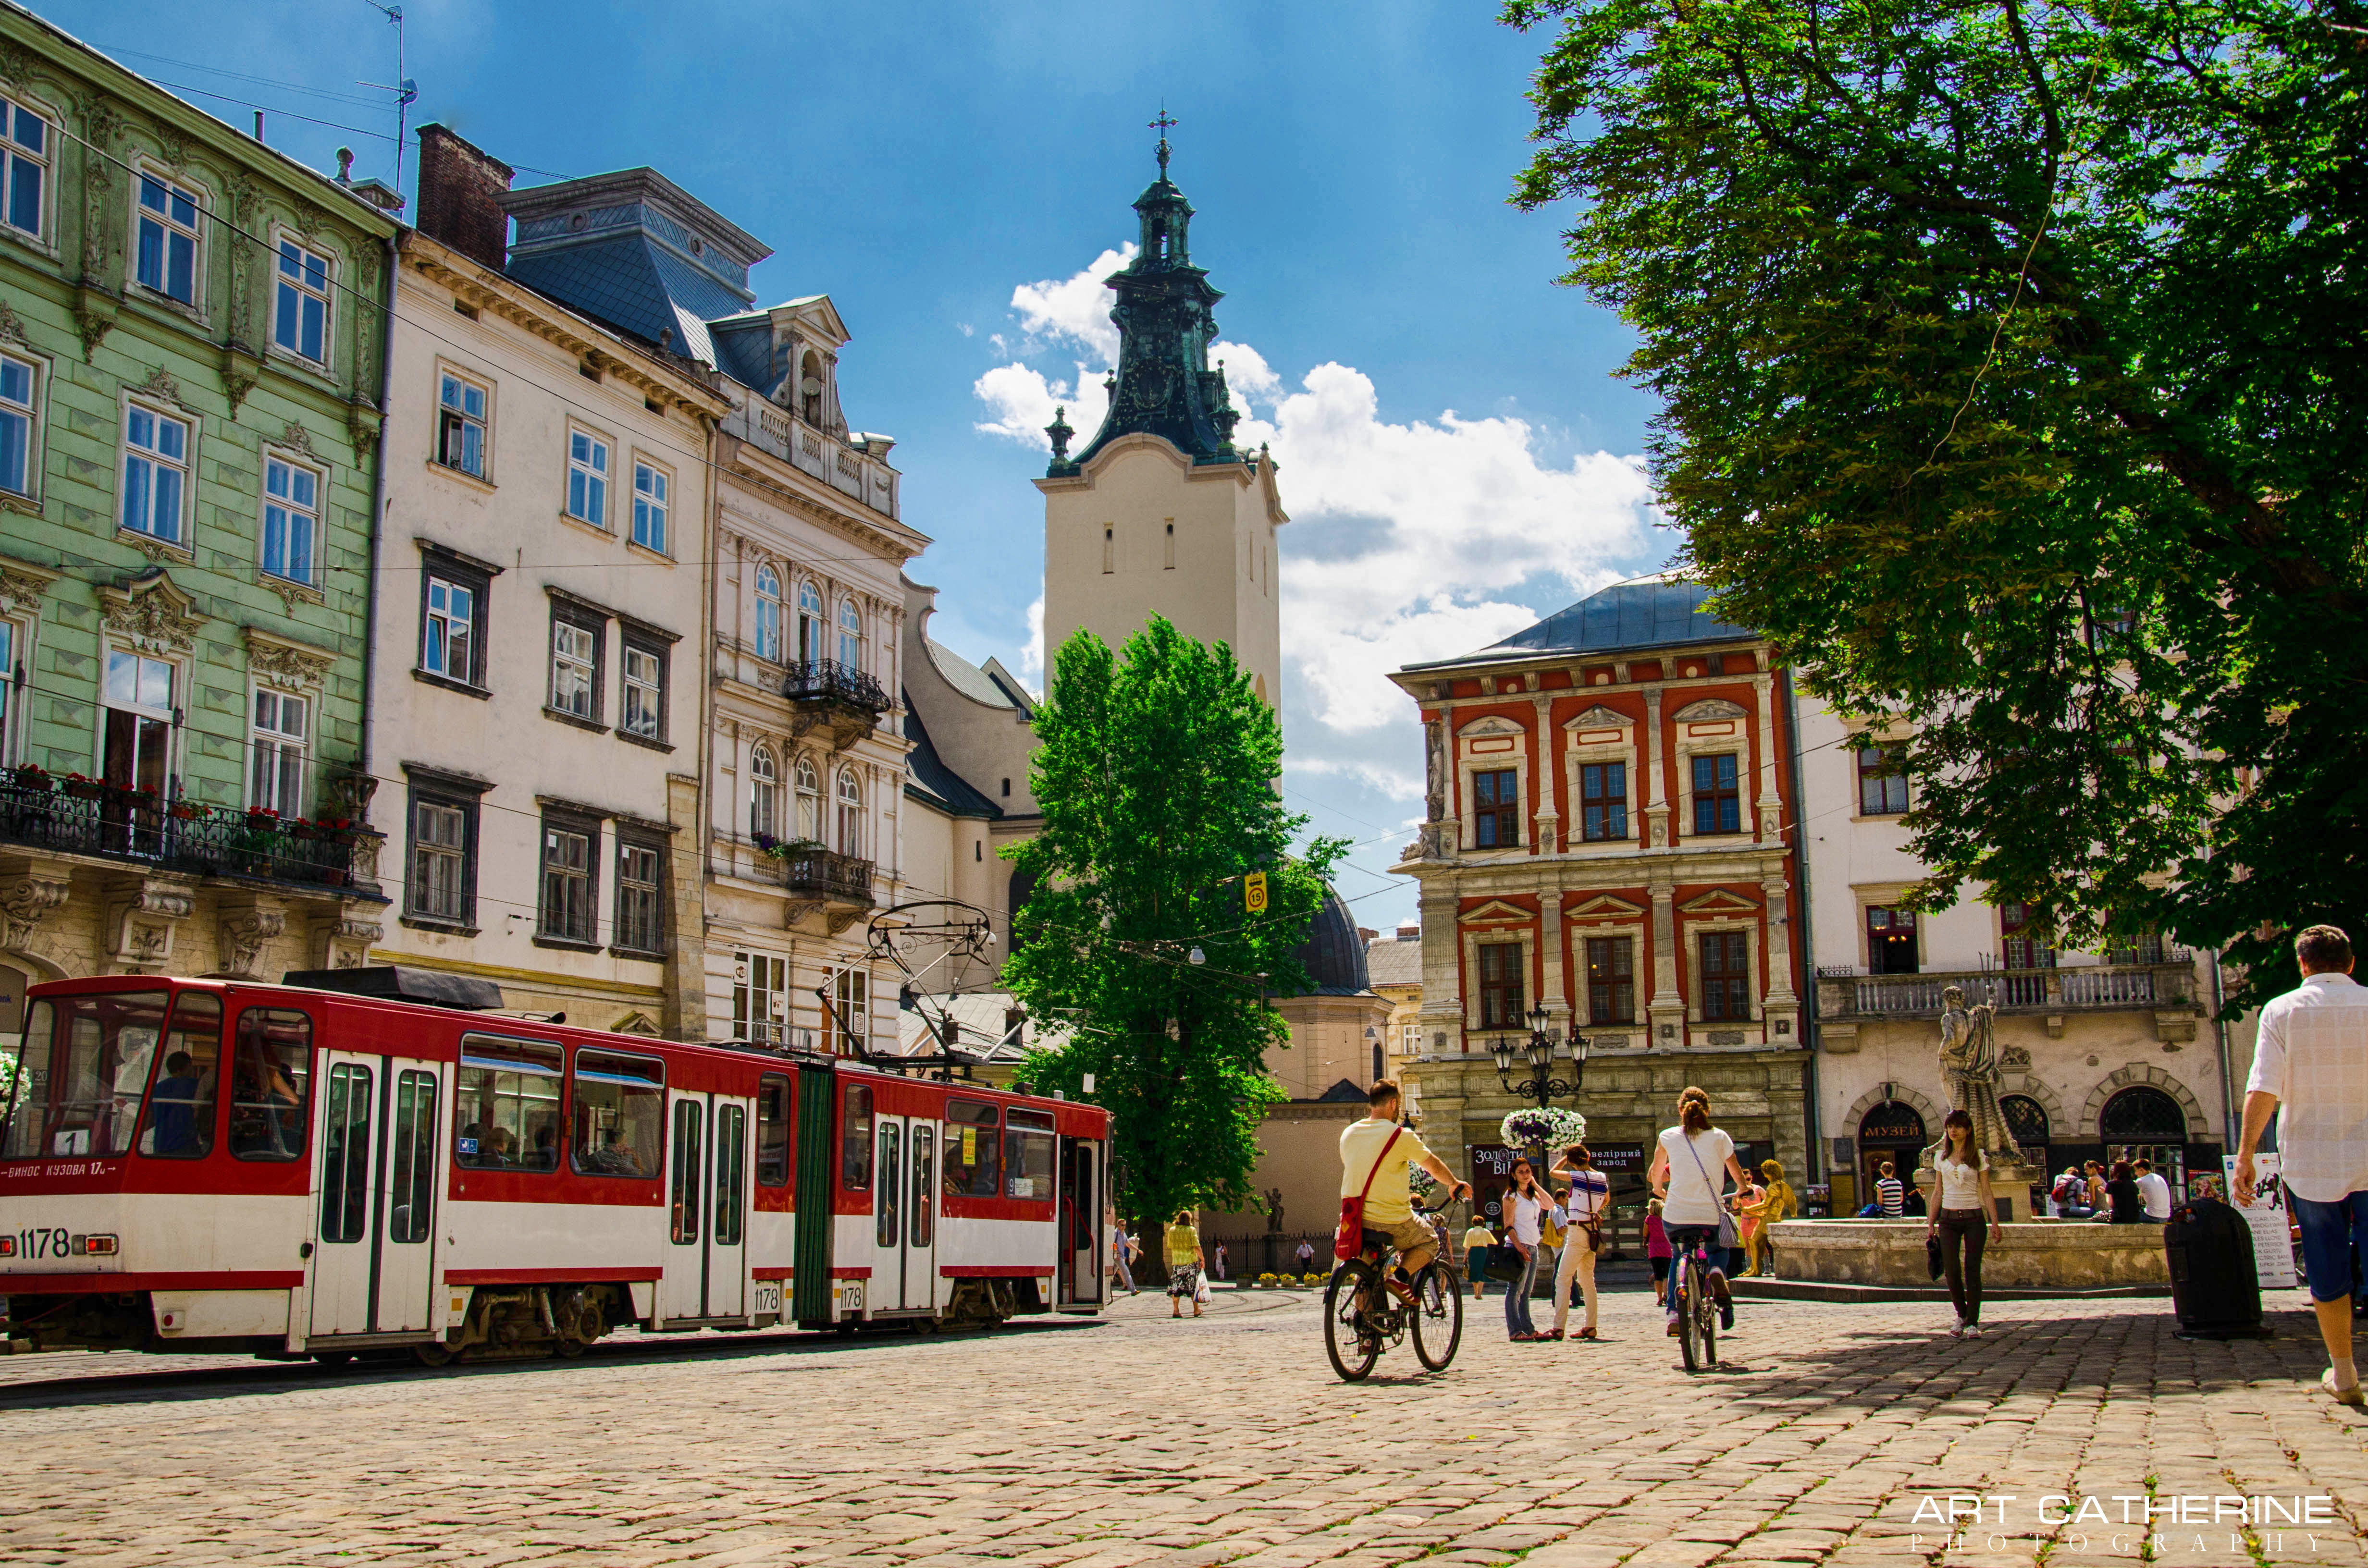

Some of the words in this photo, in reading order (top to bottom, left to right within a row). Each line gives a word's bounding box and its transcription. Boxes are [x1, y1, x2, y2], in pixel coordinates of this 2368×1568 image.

[1251, 893, 1261, 903] 15
[35, 1070, 48, 1081] 20
[1865, 1122, 1919, 1138] МУЗЕЙ
[65, 1132, 77, 1155] 1
[1591, 1149, 1641, 1158] велірний
[9, 1165, 40, 1177] ВИНОС
[46, 1164, 86, 1176] КУЗОВА
[1009, 1178, 1014, 1192] 9
[19, 1227, 71, 1259] 1178
[755, 1288, 778, 1311] 1178
[841, 1287, 861, 1309] 1178
